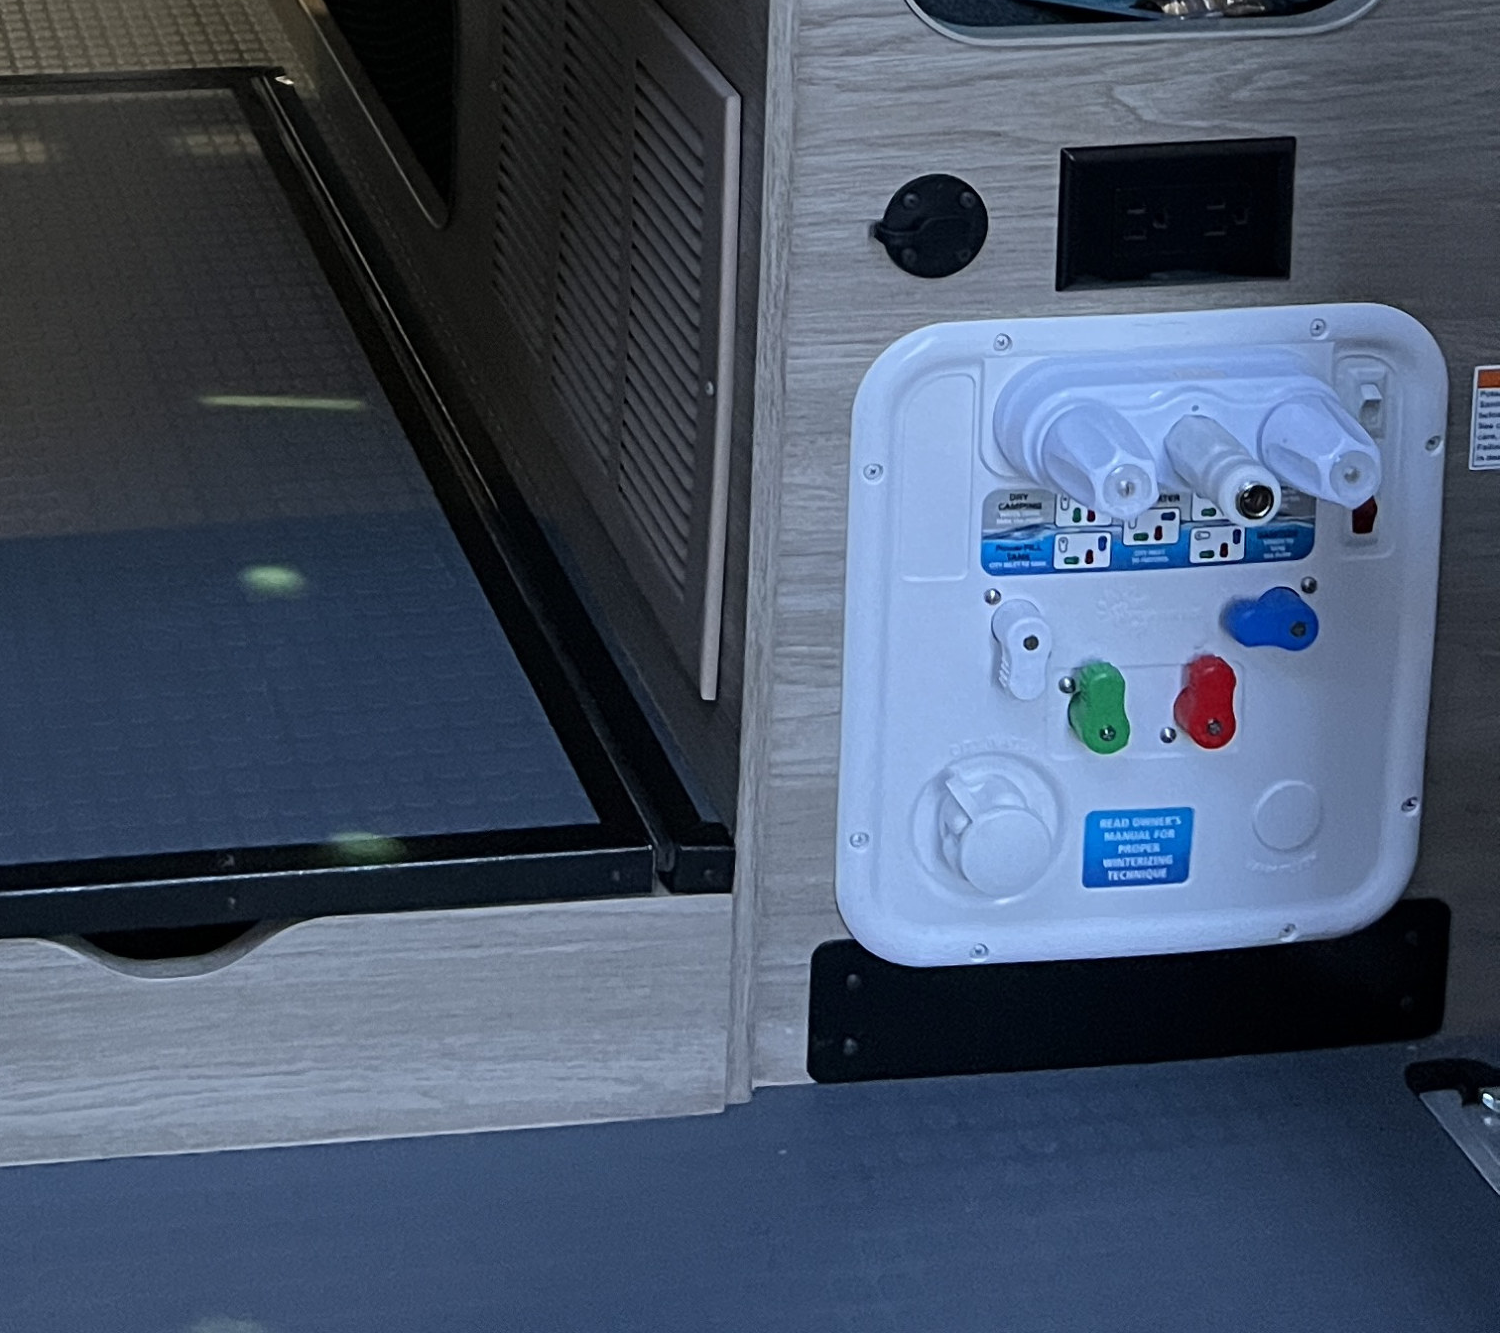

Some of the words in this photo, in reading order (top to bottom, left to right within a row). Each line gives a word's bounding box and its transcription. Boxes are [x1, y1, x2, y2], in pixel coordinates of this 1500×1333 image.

[1009, 492, 1028, 501] DRY
[998, 502, 1042, 511] CAMPING
[1099, 818, 1130, 829] READ
[1132, 816, 1182, 827] OWNER'S
[1104, 830, 1151, 841] MANUAL
[1153, 829, 1175, 839] FOR
[1117, 843, 1161, 854] PROPER
[1103, 855, 1173, 868] WINTERIZING
[1107, 868, 1167, 880] TECHNIQUE
